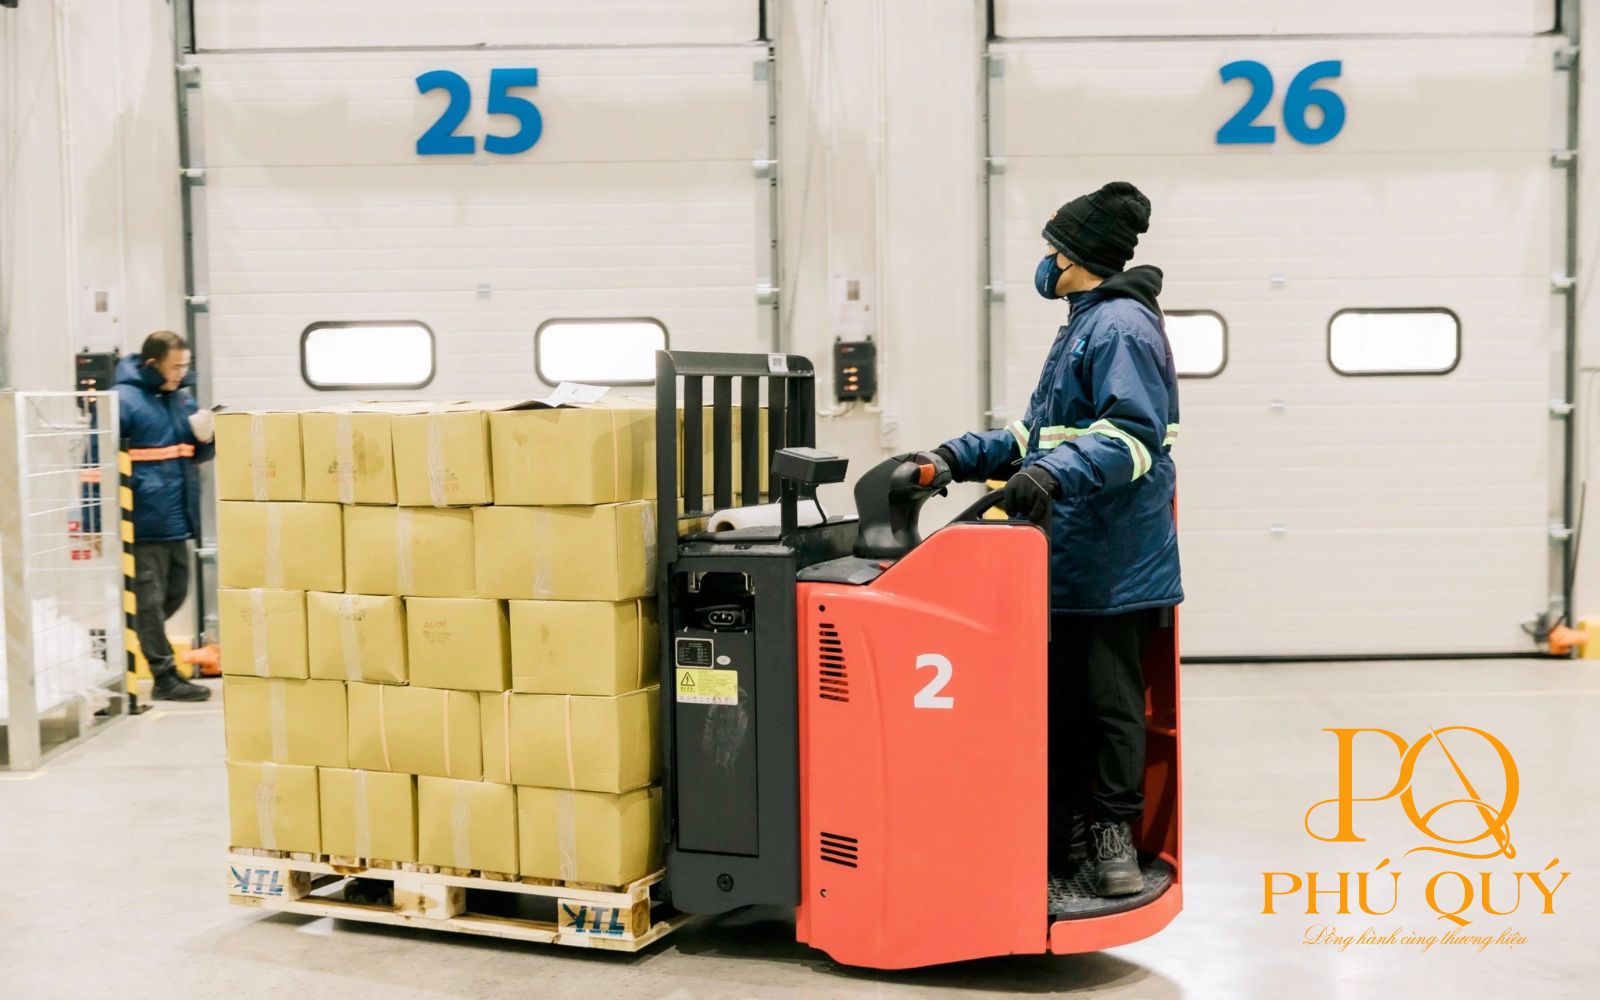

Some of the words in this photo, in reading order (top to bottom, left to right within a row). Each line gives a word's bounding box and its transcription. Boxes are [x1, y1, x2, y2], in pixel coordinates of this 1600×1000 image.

[415, 67, 543, 155] 25
[1216, 59, 1346, 145] 26
[913, 653, 955, 709] 2
